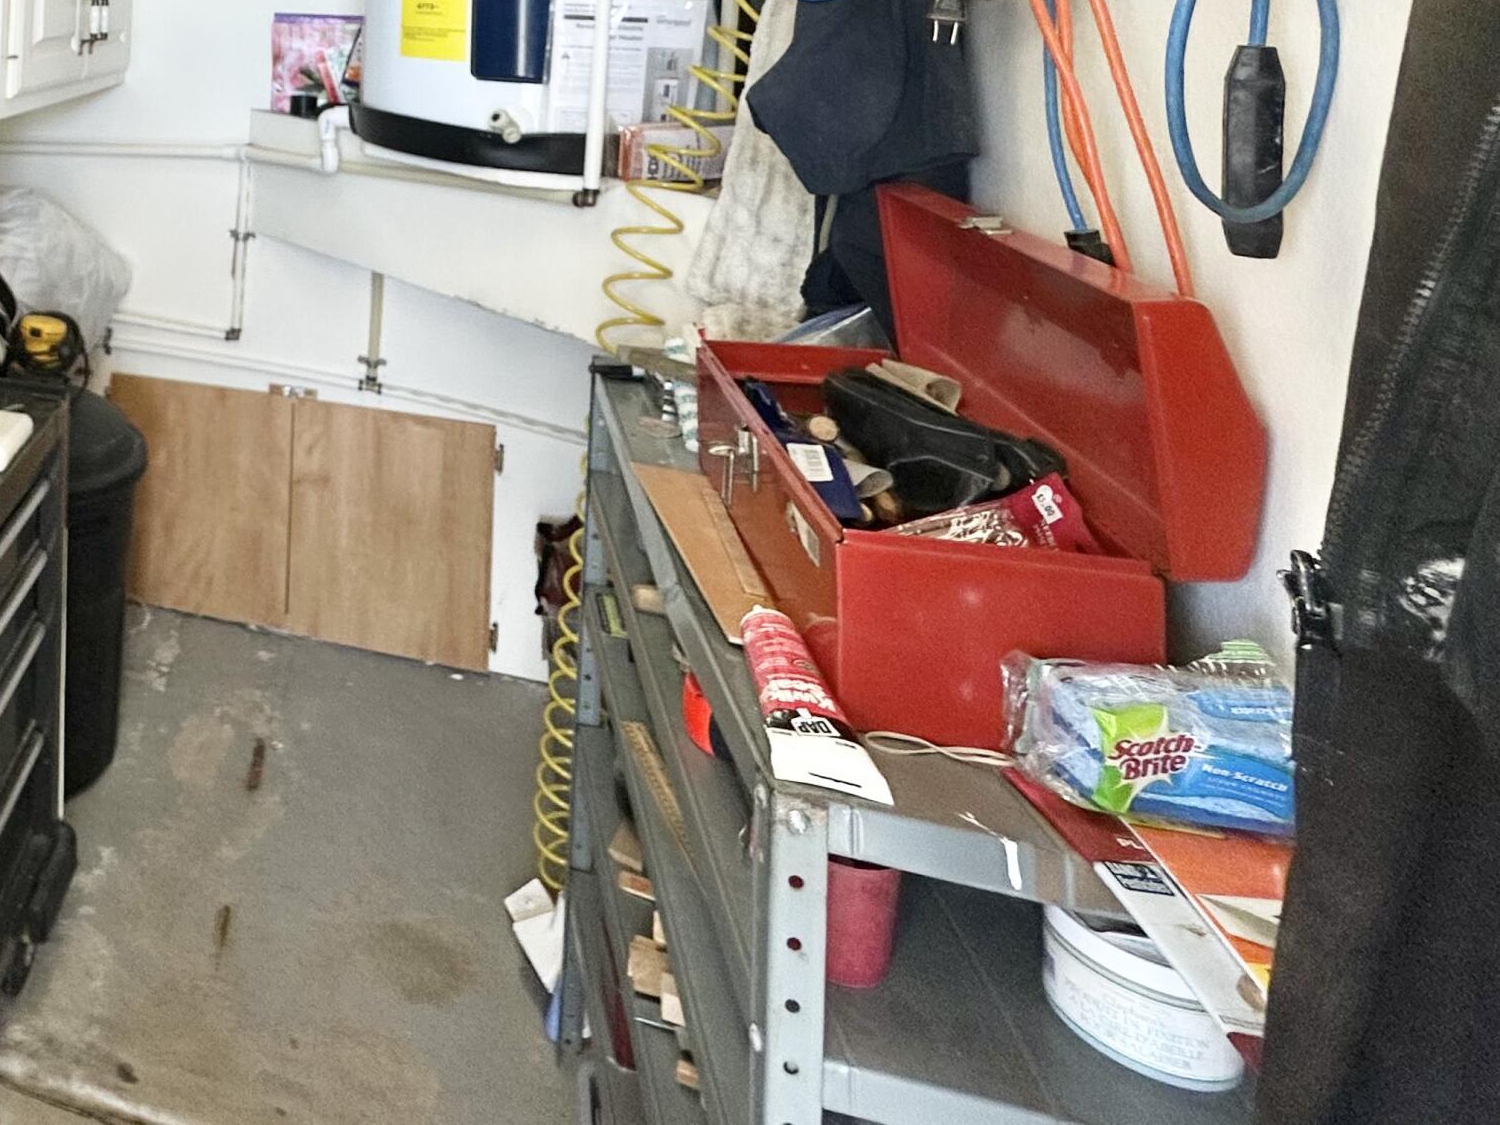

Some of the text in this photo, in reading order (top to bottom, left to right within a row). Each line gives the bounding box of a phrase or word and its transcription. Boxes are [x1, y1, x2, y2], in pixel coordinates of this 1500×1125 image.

[798, 720, 833, 734] DAP
[1119, 755, 1186, 780] Brite
[1201, 763, 1289, 792] Non-Scratch
